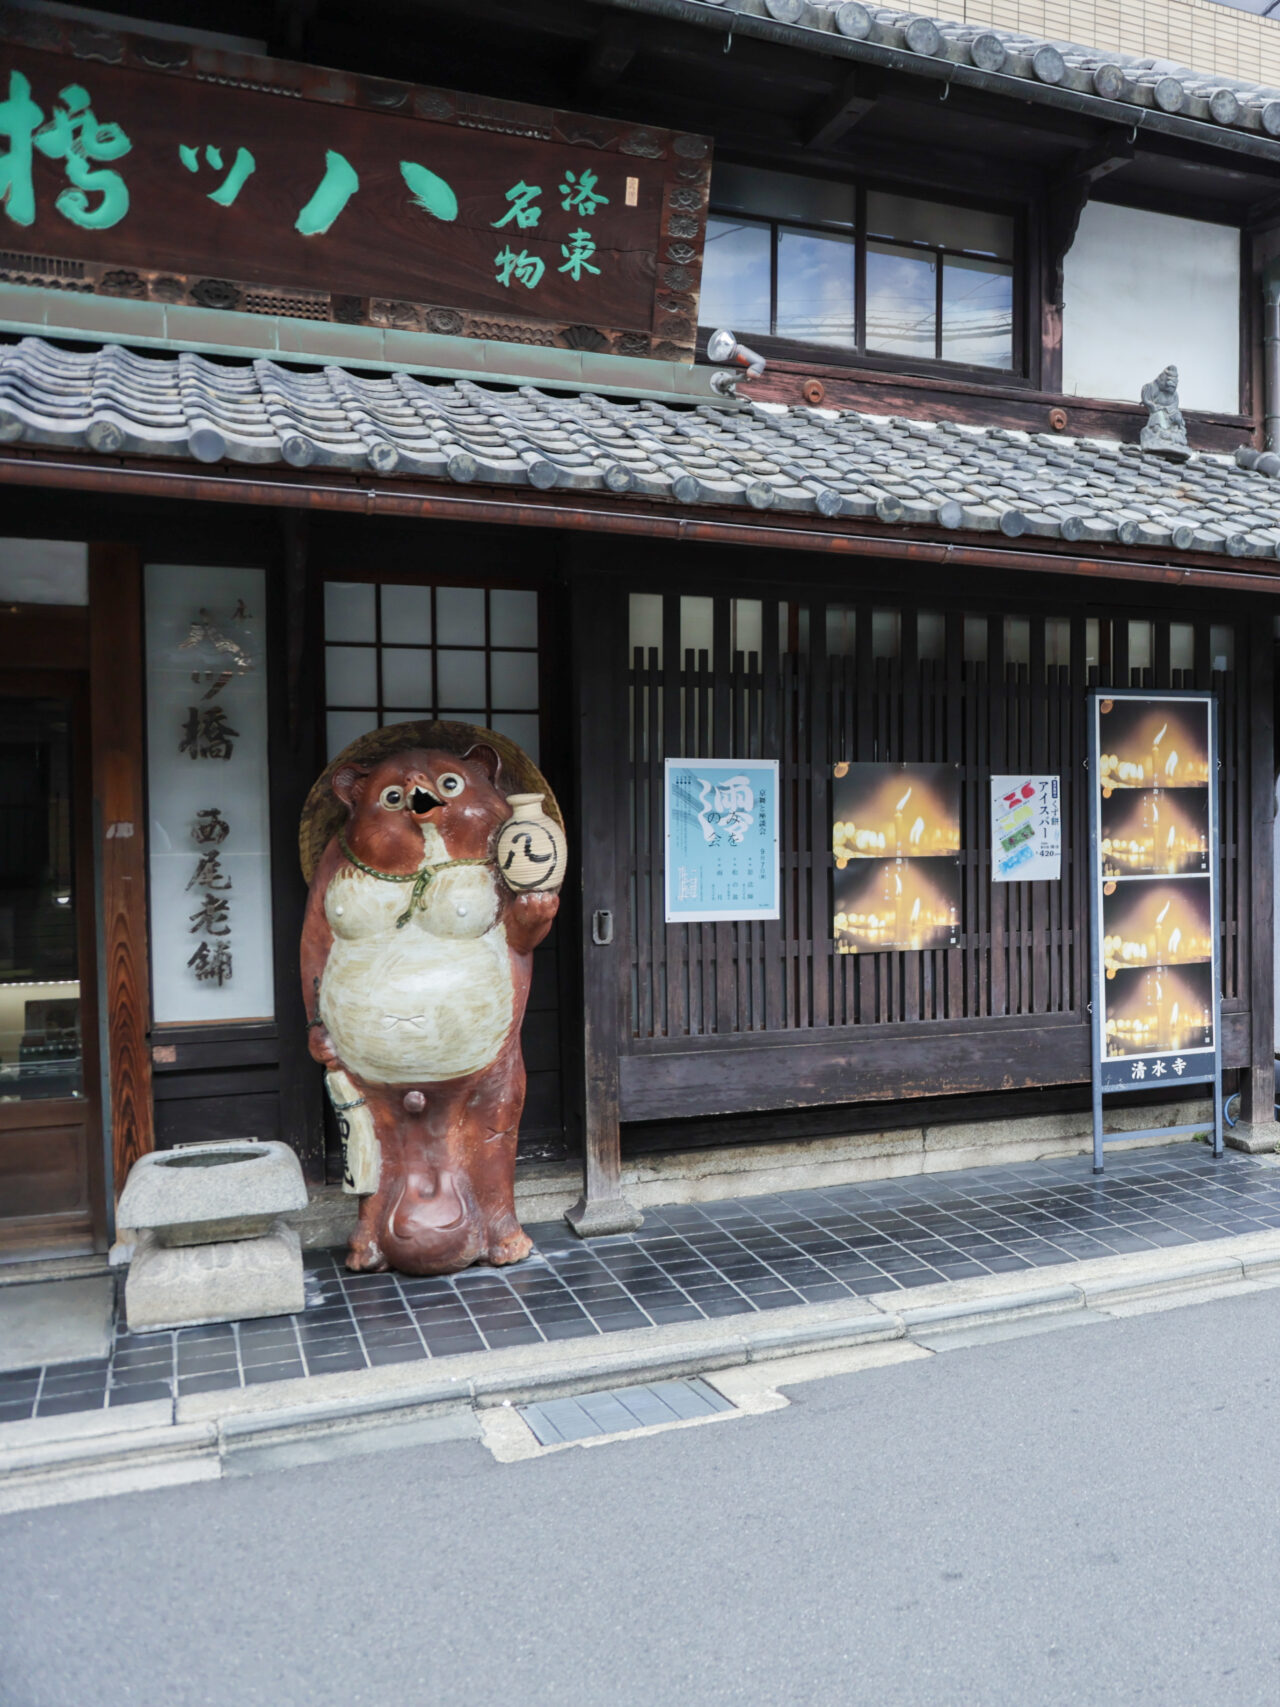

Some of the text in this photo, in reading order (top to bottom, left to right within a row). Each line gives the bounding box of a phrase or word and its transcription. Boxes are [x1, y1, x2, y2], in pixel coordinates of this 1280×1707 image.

[489, 179, 546, 289] 名物
[557, 168, 610, 282] 洛東
[1039, 781, 1050, 839] アイスバー
[1131, 1057, 1187, 1080] 清水寺
